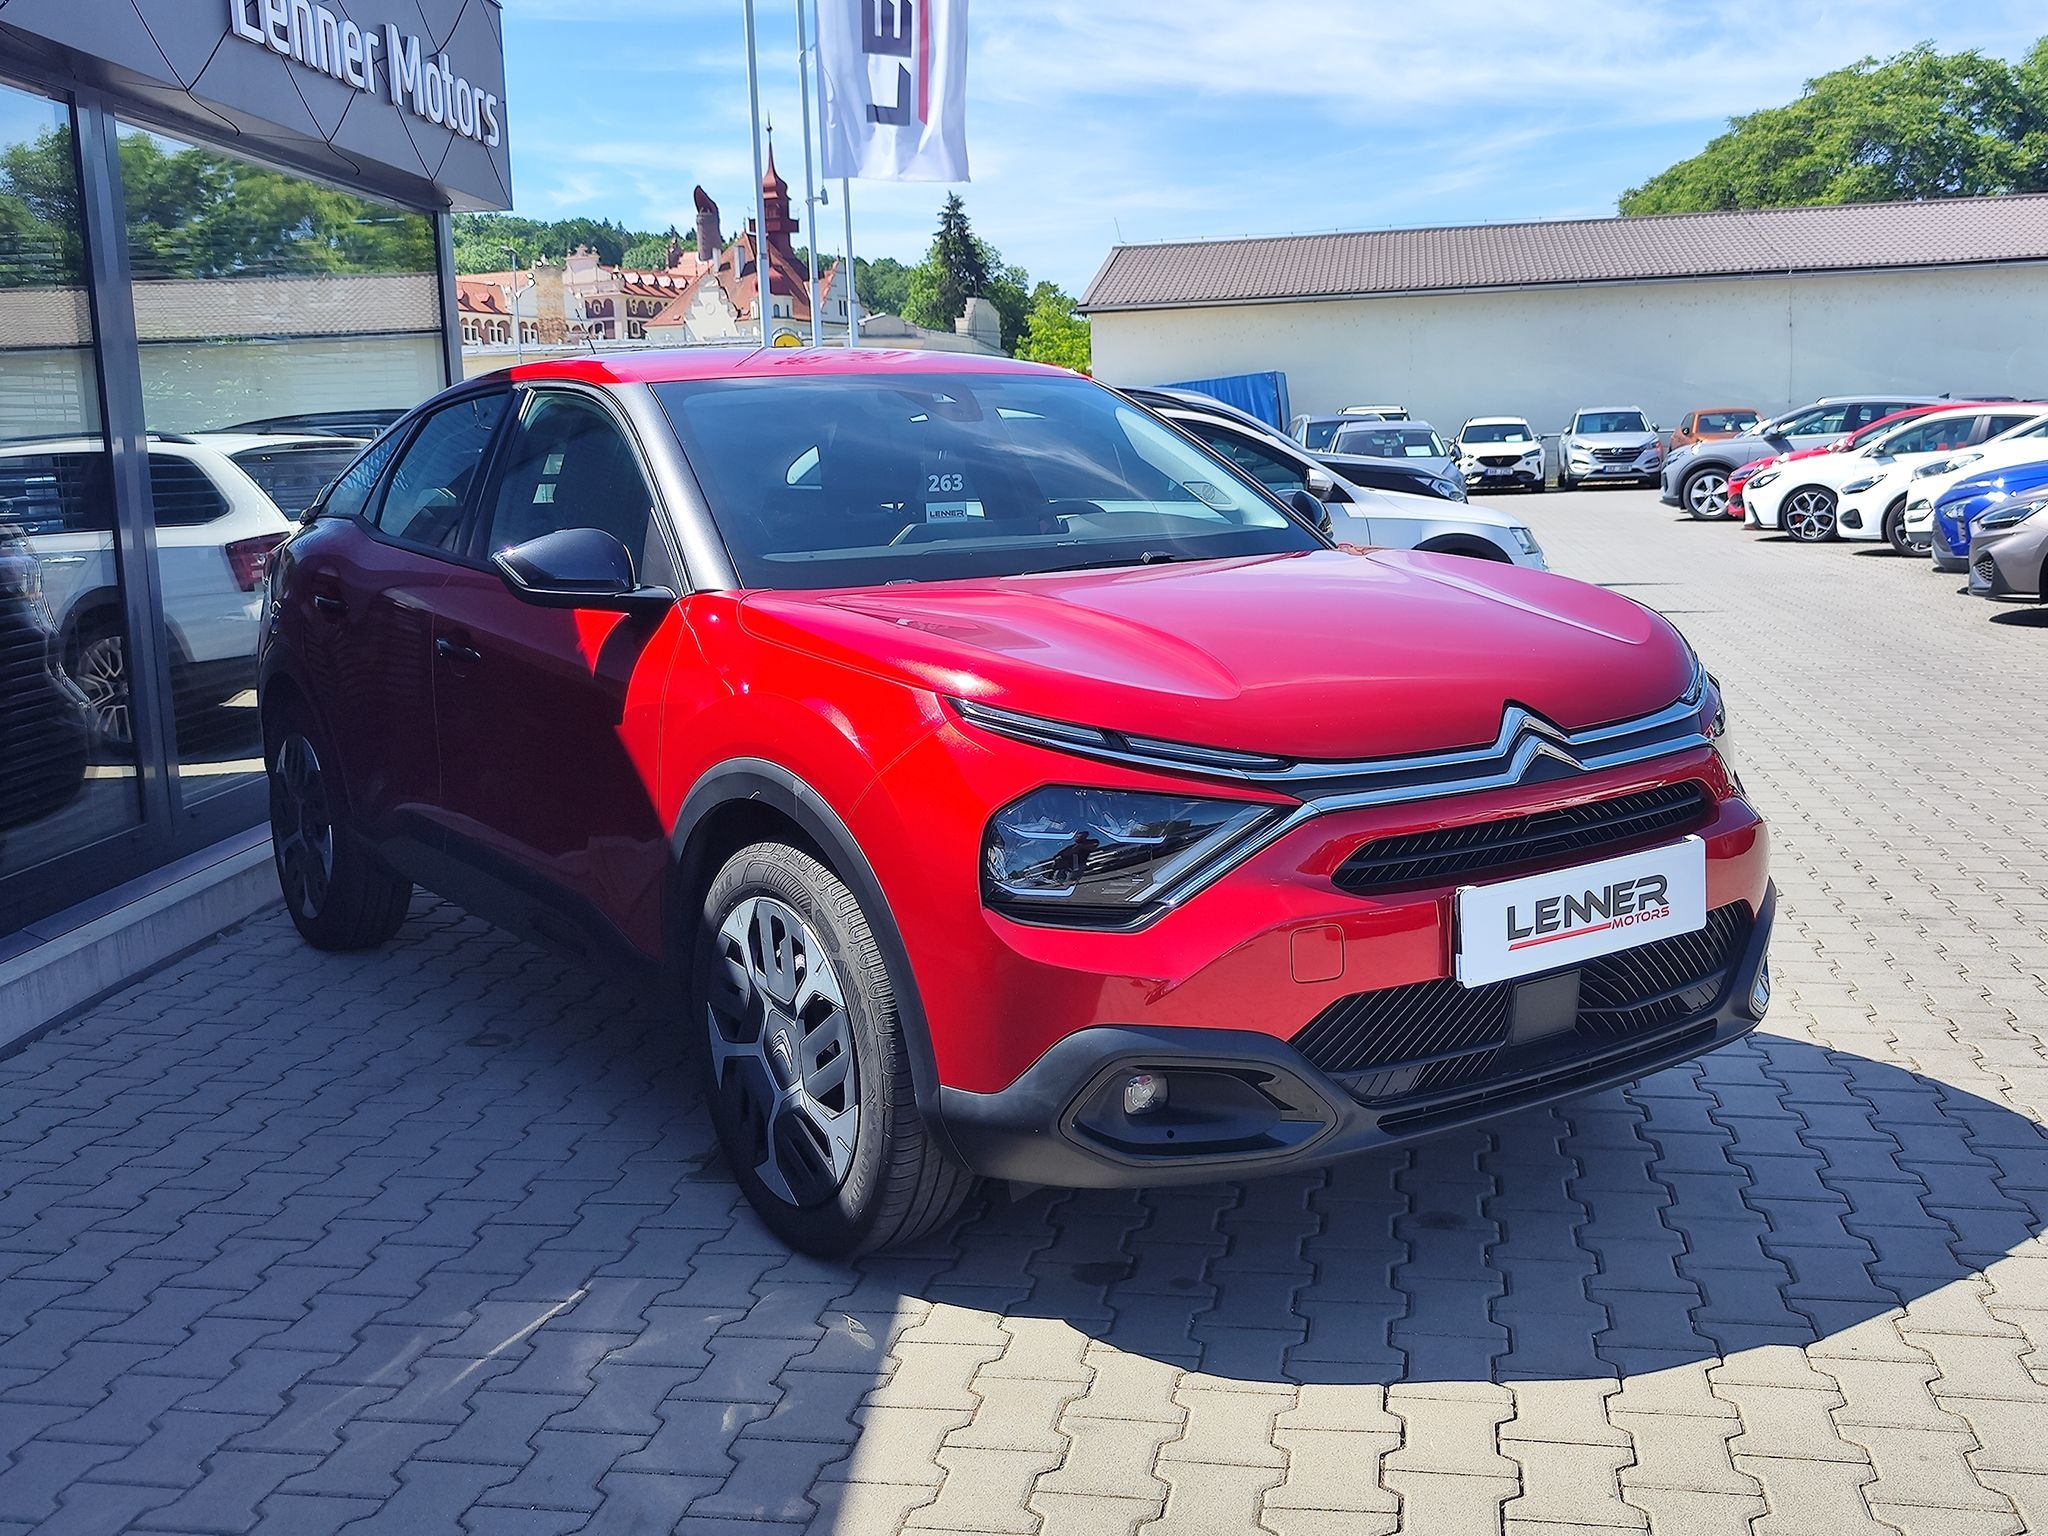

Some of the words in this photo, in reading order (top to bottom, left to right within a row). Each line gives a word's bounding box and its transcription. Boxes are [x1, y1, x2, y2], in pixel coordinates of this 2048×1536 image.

[230, 0, 380, 94] Lenner
[384, 23, 501, 147] Motors
[928, 473, 963, 492] 263
[929, 509, 965, 518] LENNER
[1507, 874, 1669, 941] LENNER
[1611, 906, 1670, 930] MOTORS
